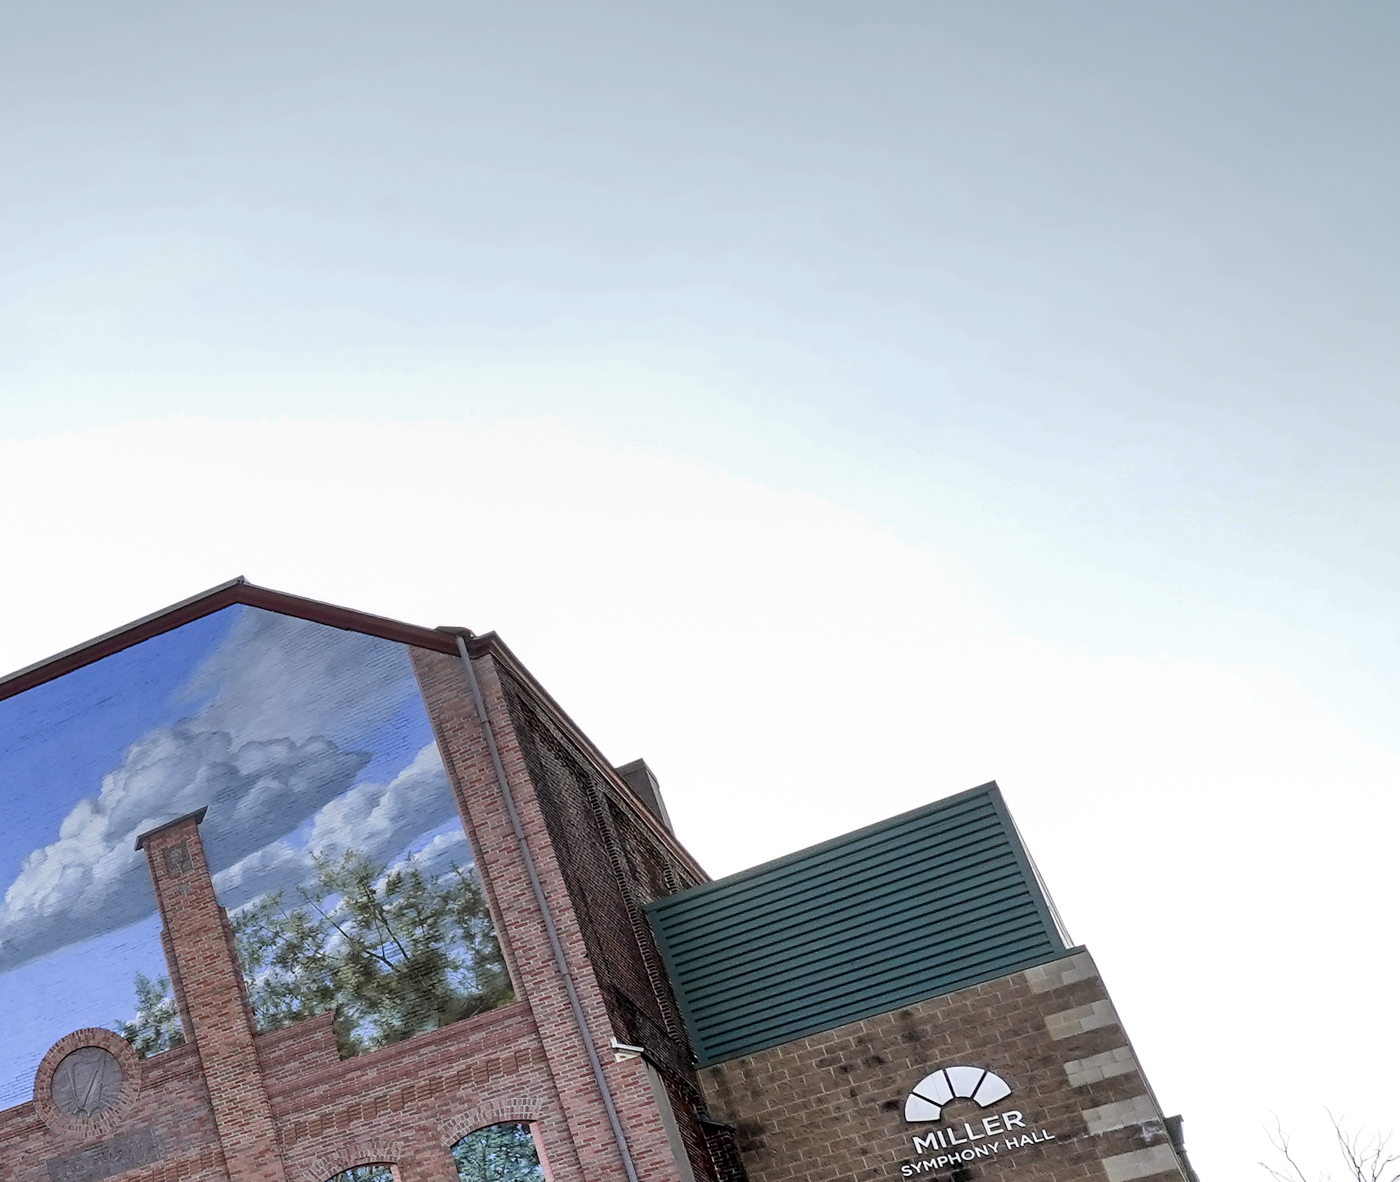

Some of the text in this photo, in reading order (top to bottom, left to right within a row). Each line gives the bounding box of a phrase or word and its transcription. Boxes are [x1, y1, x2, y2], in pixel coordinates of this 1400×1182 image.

[901, 1129, 1056, 1177] SYMPHONY HALL
[912, 1110, 1026, 1154] MILLER
